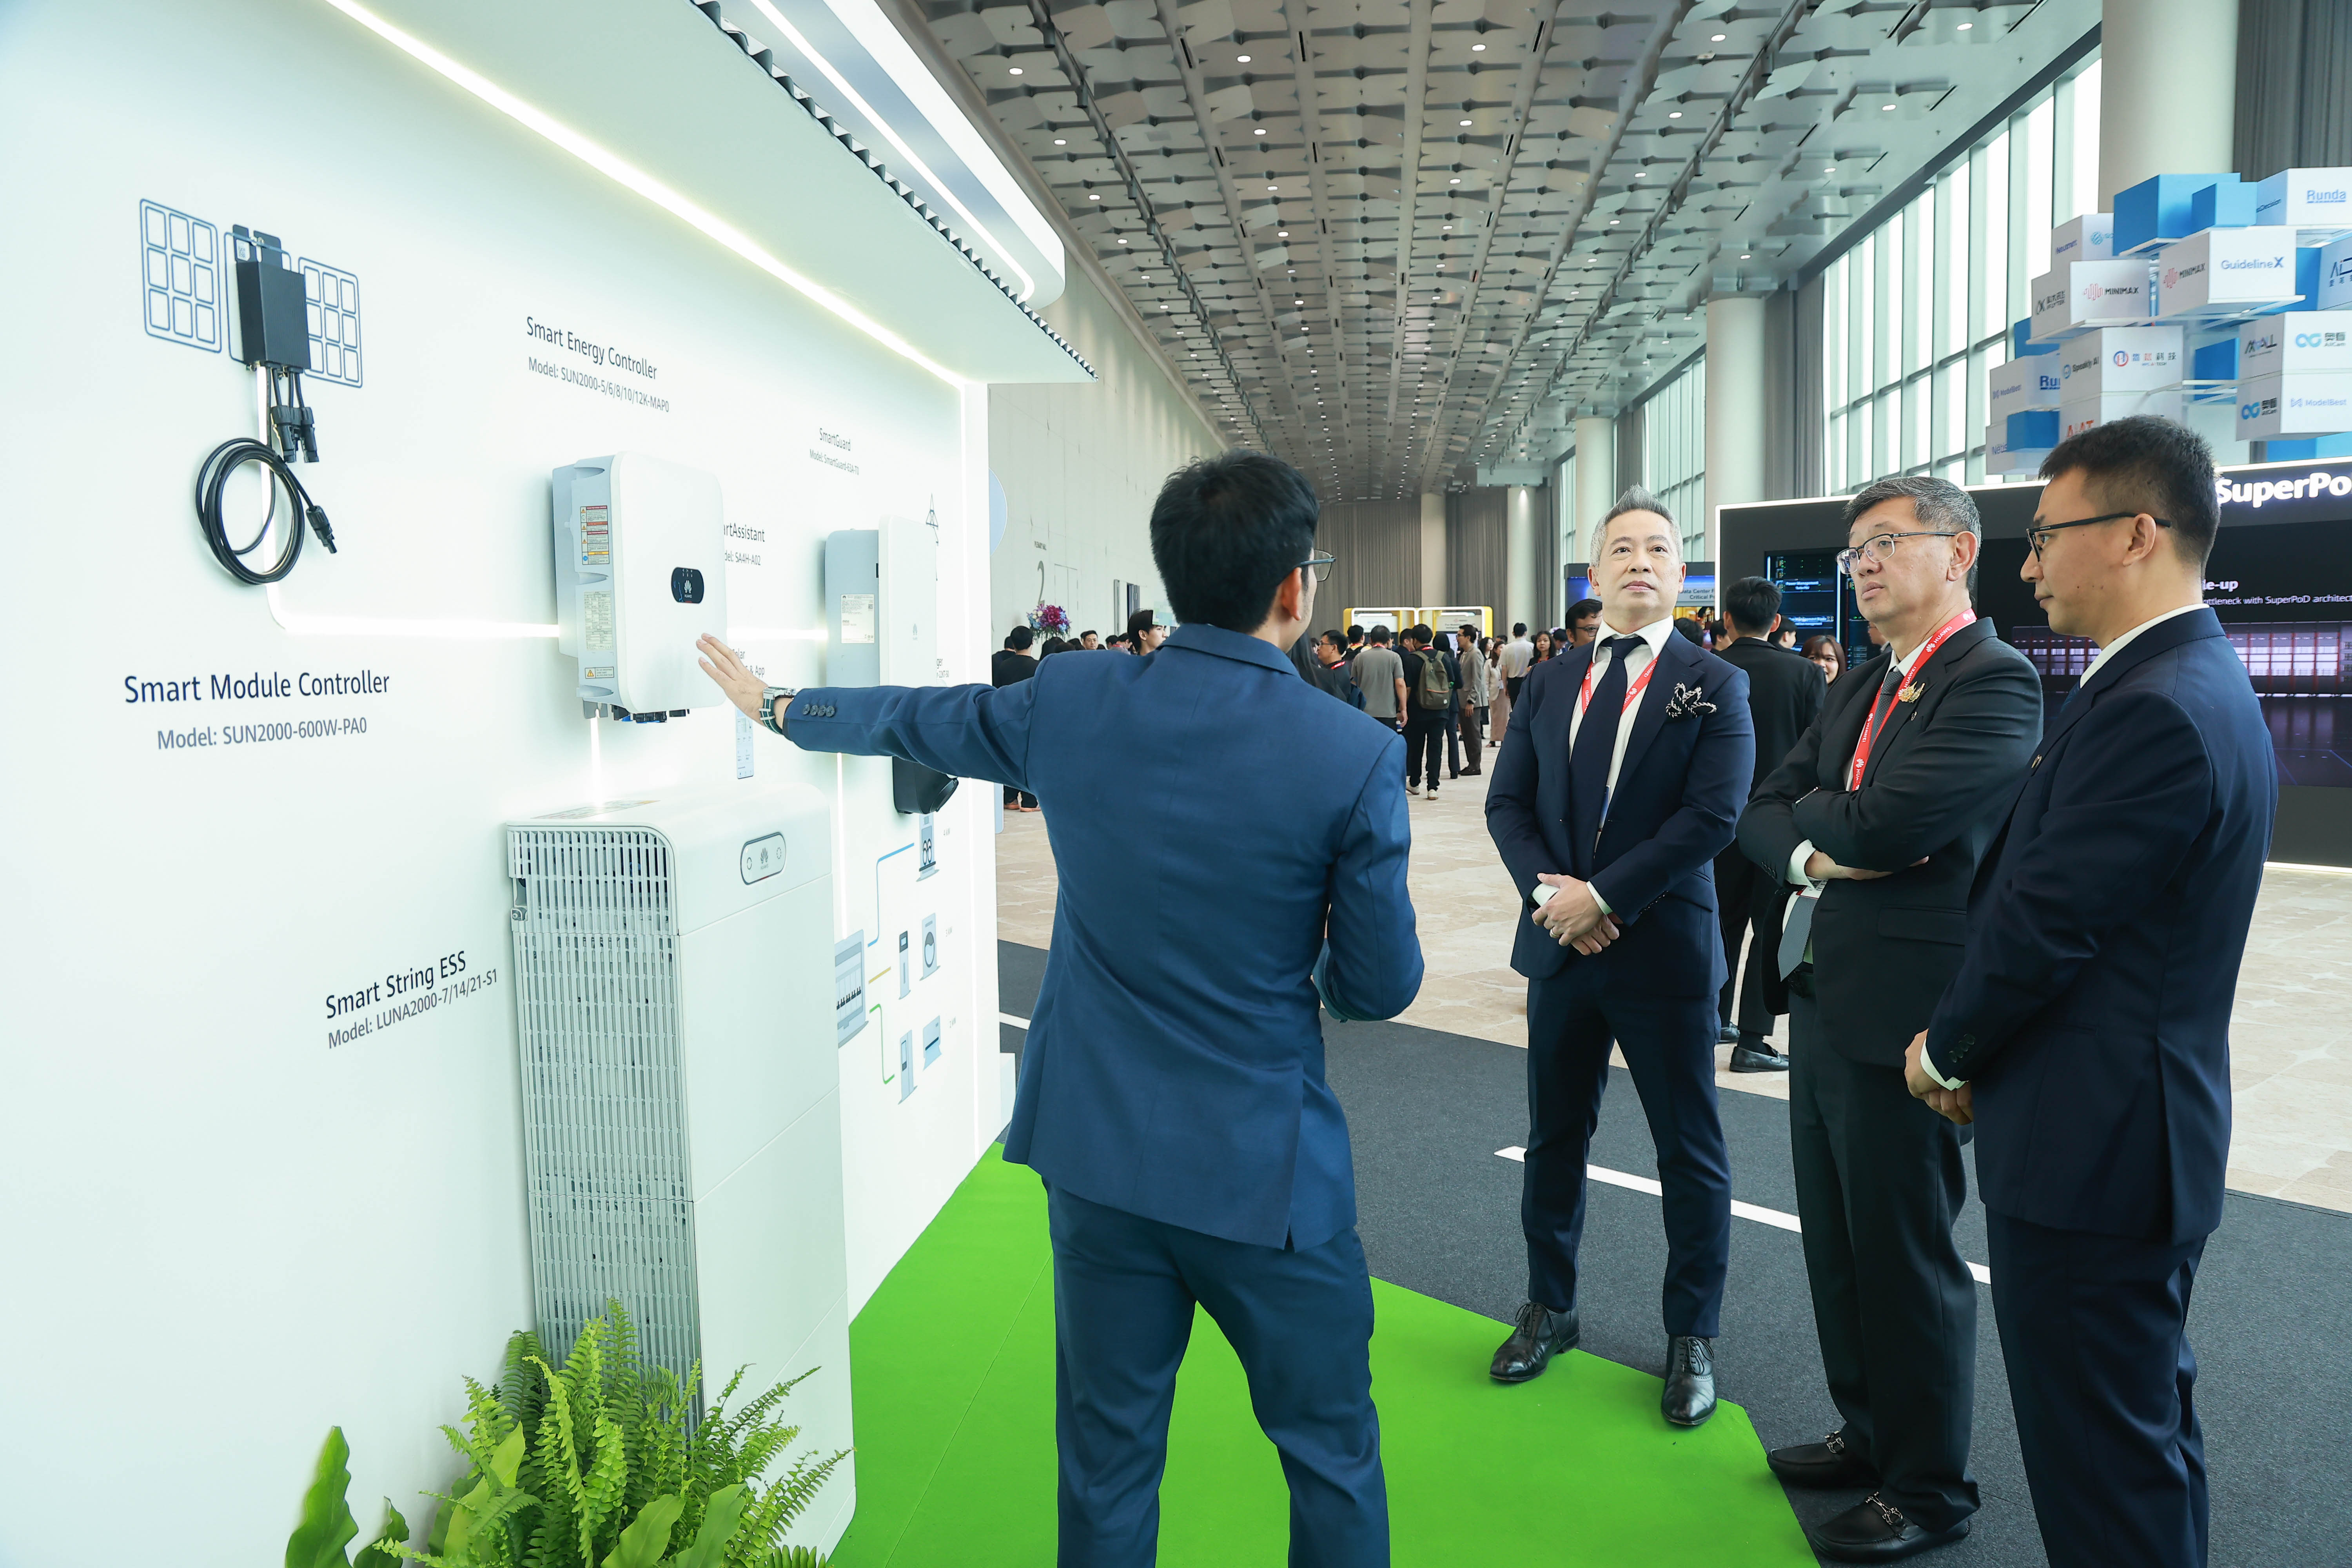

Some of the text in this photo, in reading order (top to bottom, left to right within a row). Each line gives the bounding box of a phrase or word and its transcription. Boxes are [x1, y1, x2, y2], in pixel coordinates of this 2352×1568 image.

[2307, 189, 2346, 200] Runda
[2180, 263, 2205, 279] MINIMAX
[2221, 256, 2284, 269] GuidelineX
[2105, 287, 2139, 295] MINIMAX
[527, 316, 657, 380] Smart Energy Controller
[529, 356, 669, 413] Model: SUN2000-5/6/8/10/12K-MAP0
[2040, 376, 2060, 386] Ru
[2305, 398, 2347, 407] ModelBest
[819, 428, 850, 451] SmartGuard
[809, 449, 823, 463] Model:
[2215, 472, 2352, 508] SuperPo
[735, 552, 761, 565] SA4H-A02
[1037, 560, 1045, 607] 2
[2243, 596, 2263, 604] with
[2265, 595, 2310, 605] SuperPoD
[1933, 626, 1953, 643] HUAWEI
[755, 665, 764, 678] App
[1904, 666, 1916, 688] HUAWEI
[124, 670, 390, 703] Smart Module Controller
[157, 717, 367, 750] Model: SUN2000-600W-PA0
[326, 950, 466, 1019] Smart String ESS
[328, 969, 497, 1049] Model: LUNA2000-7/14/21-S1
